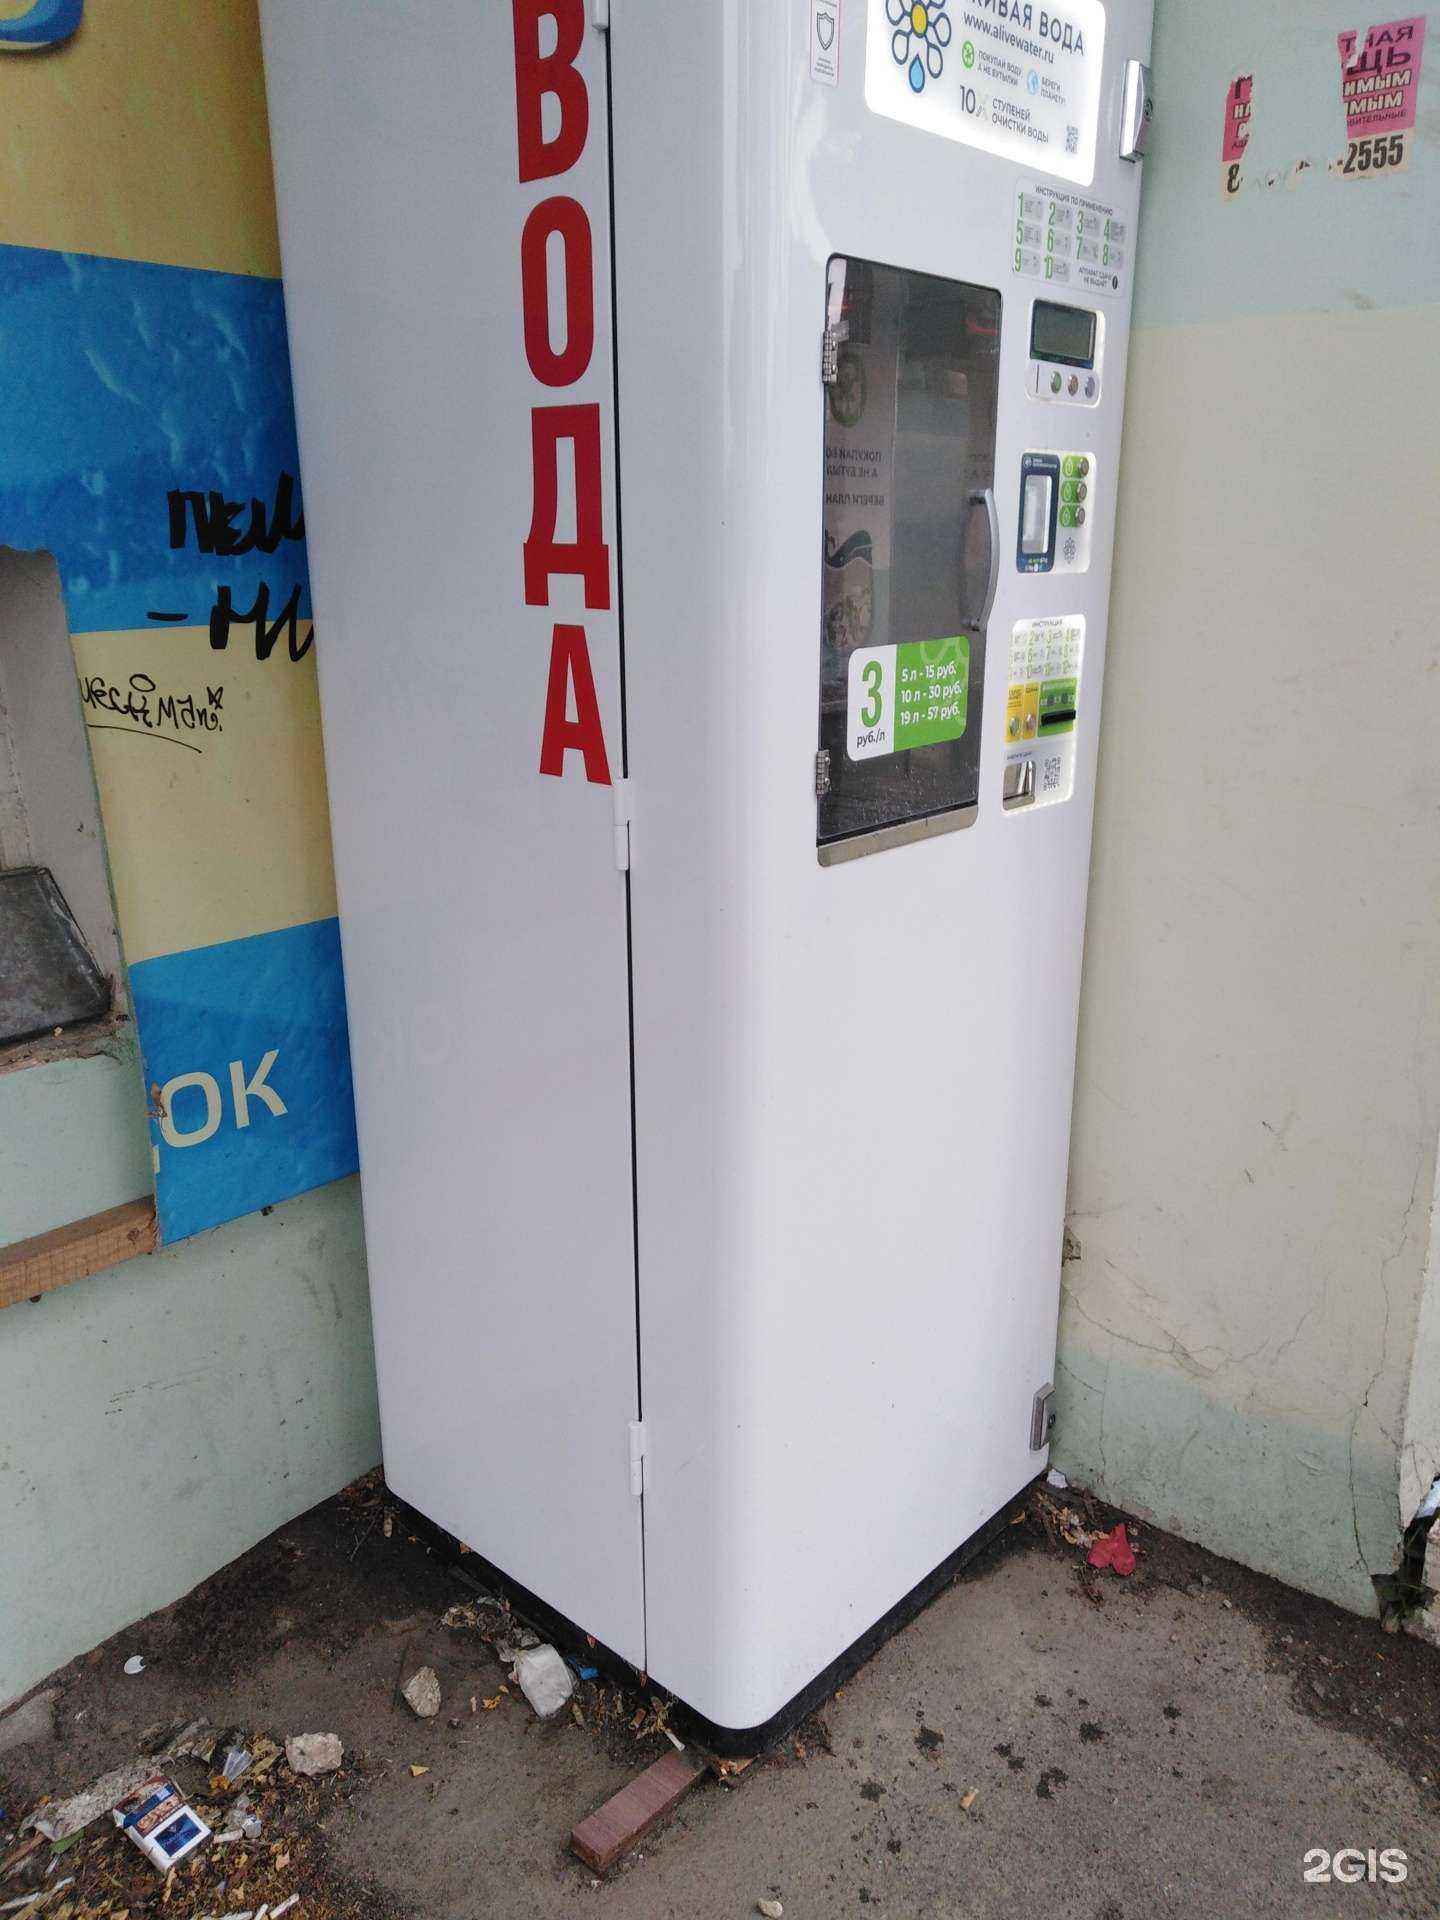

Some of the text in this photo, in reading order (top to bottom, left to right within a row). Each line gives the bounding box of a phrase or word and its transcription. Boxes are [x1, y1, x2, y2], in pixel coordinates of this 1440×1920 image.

[963, 12, 1054, 63] www.alivewater.ru
[972, 0, 1084, 56] ИВАЯ ВОДА
[960, 84, 976, 114] 10
[992, 98, 1031, 121] СТУПЕНЕЙ
[991, 113, 1049, 144] ОЧИСТКИ ВОДЫ
[1343, 134, 1404, 174] 2555
[512, 0, 613, 786] ВОДА
[901, 668, 909, 682] 5
[910, 670, 917, 681] л
[925, 665, 935, 679] 15
[936, 661, 957, 680] руб.
[861, 660, 883, 728] 3
[901, 690, 912, 703] 10
[914, 691, 920, 701] л
[928, 684, 940, 699] 30
[942, 681, 962, 699] руб.
[900, 711, 911, 725] 19
[912, 712, 919, 723] л
[927, 706, 938, 720] 57
[940, 702, 960, 720] руб.
[857, 728, 886, 748] руб./л
